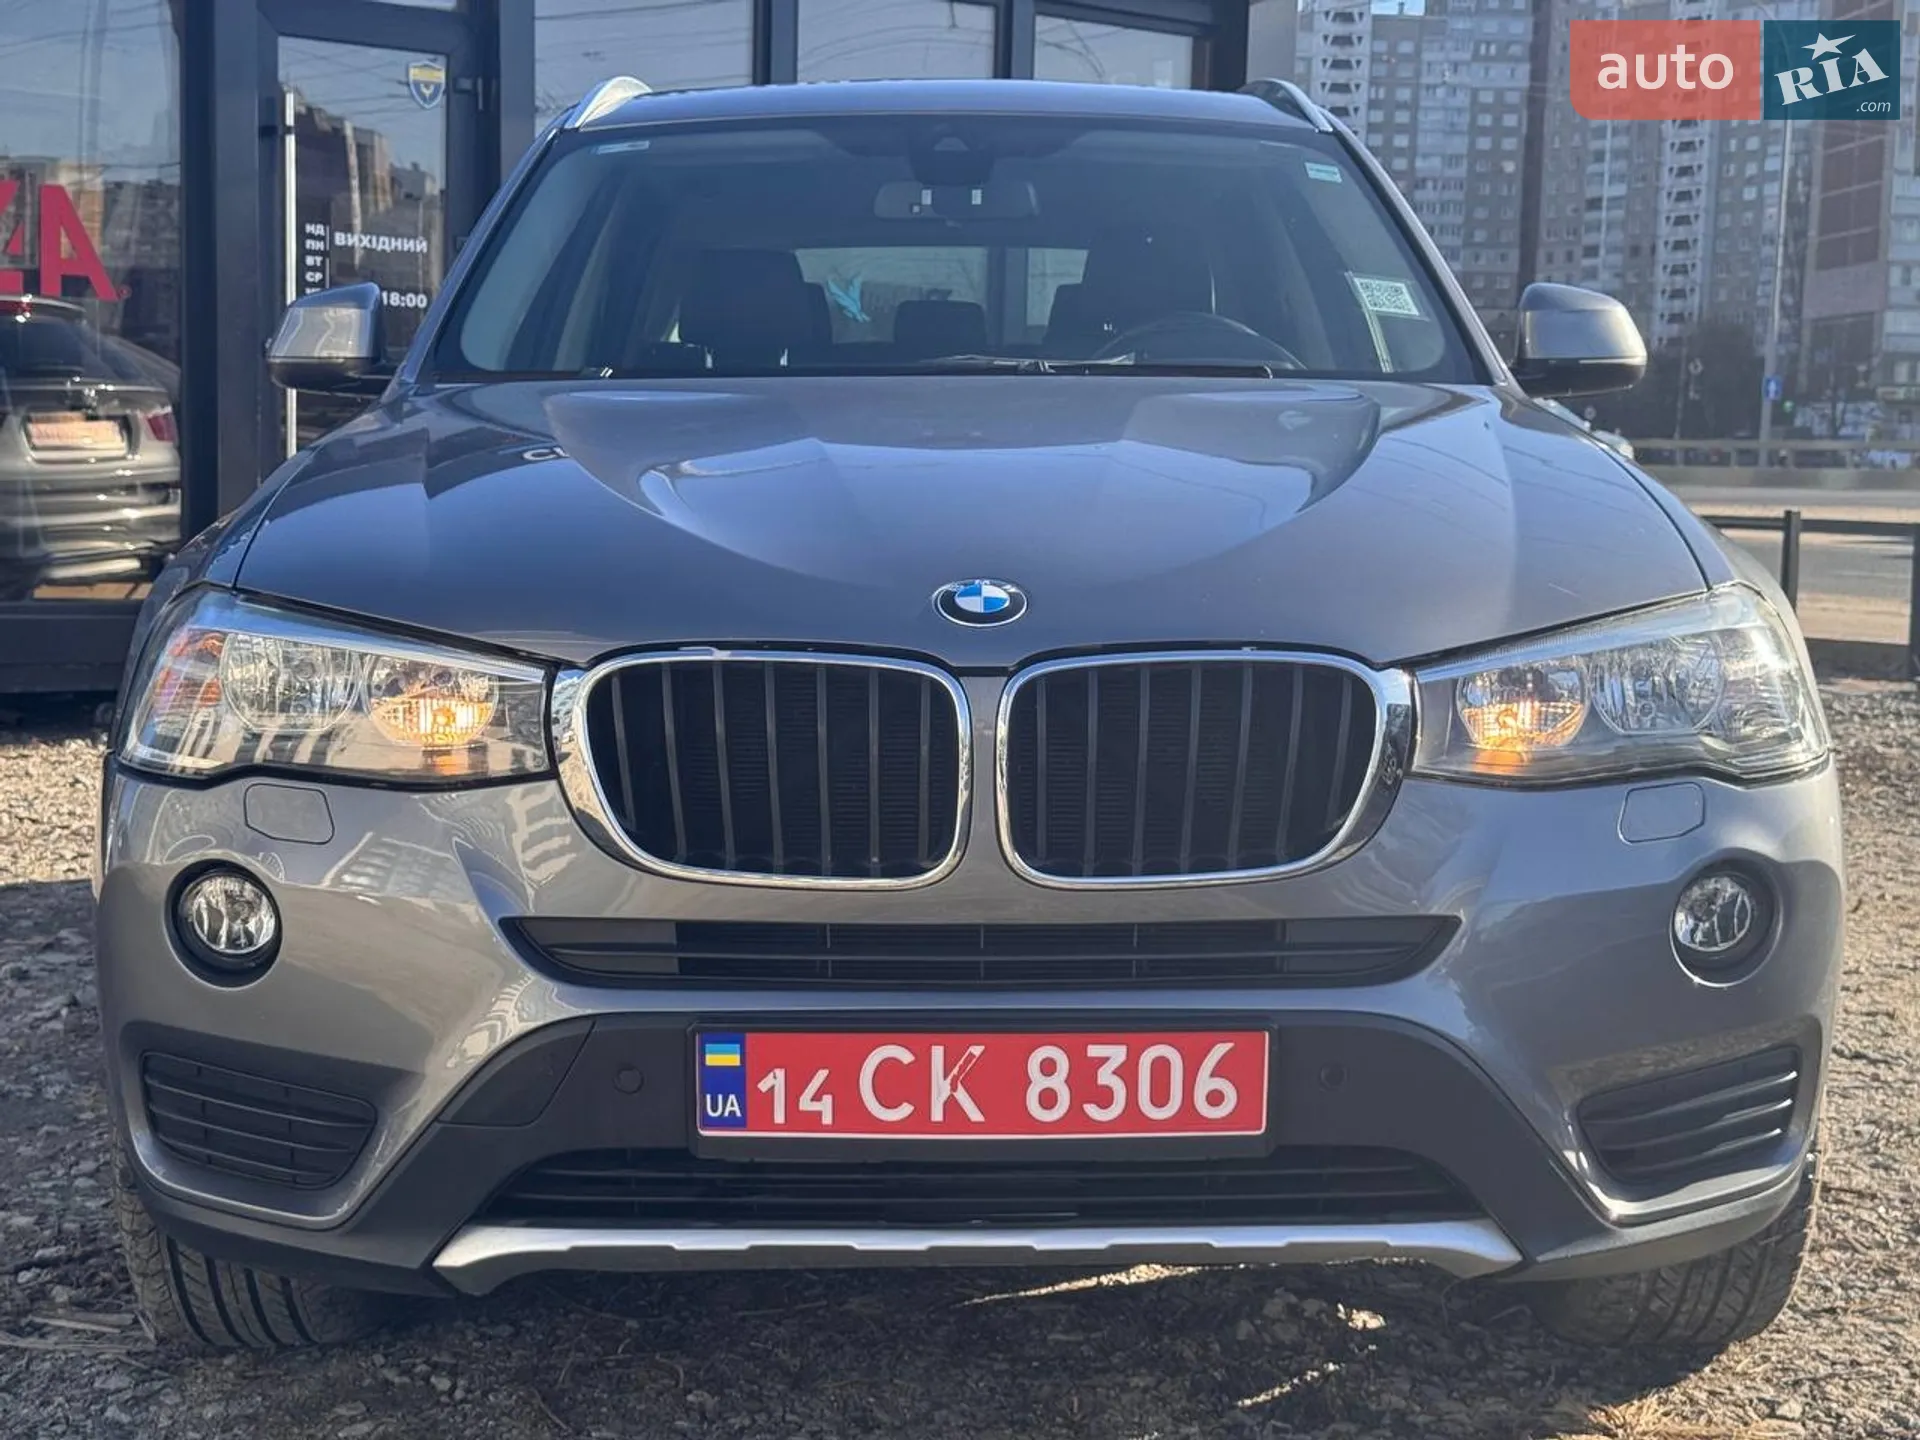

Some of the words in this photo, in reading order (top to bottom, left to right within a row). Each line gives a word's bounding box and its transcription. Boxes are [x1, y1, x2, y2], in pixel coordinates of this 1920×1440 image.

[334, 231, 428, 254] ВИХІДНИЙ
[757, 1067, 833, 1125] 14
[858, 1044, 986, 1122] CK
[1025, 1042, 1238, 1122] 8306
[705, 1093, 741, 1118] UA
